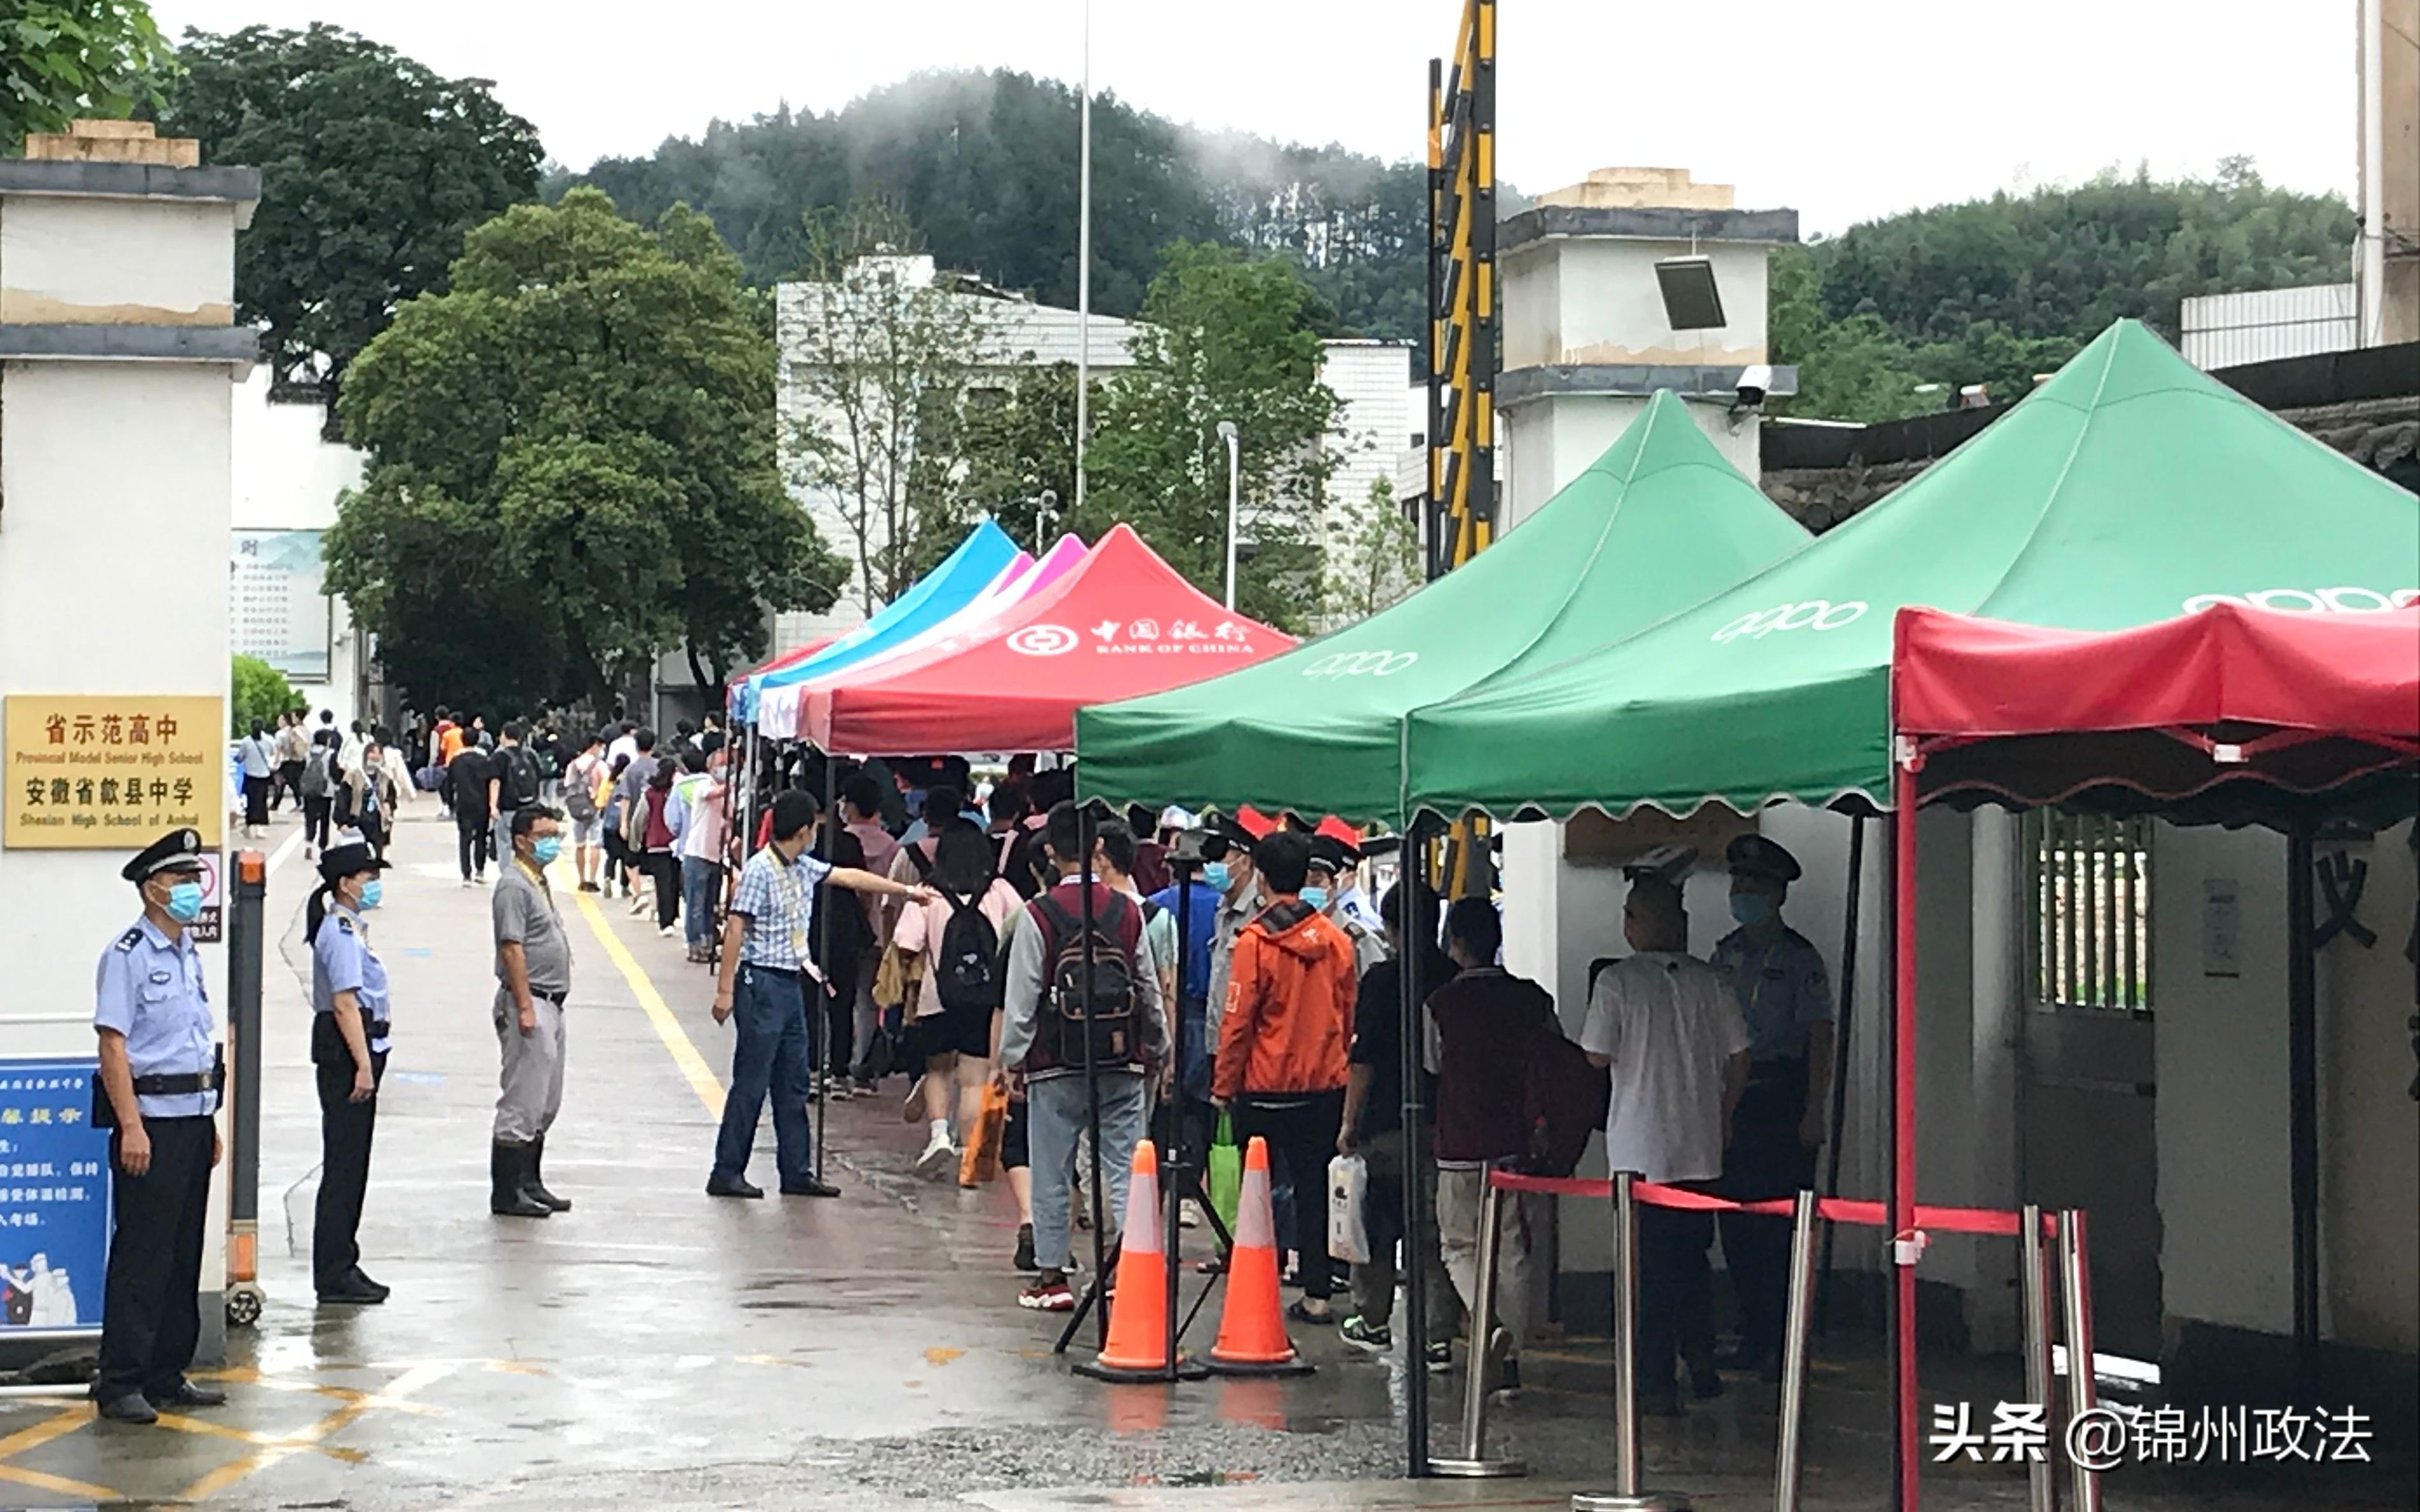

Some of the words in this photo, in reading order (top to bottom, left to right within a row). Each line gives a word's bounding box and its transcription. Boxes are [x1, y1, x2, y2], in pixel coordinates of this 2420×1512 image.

[1096, 645, 1153, 654] BANK
[1157, 645, 1183, 654] OF
[1188, 645, 1254, 654] CHINA
[46, 713, 178, 745] 省示范高中
[69, 752, 101, 764] Model
[141, 752, 164, 767] High
[169, 752, 204, 764] School
[26, 777, 193, 806] 安徽省歙县中学
[104, 814, 141, 826] School
[149, 814, 159, 826] of
